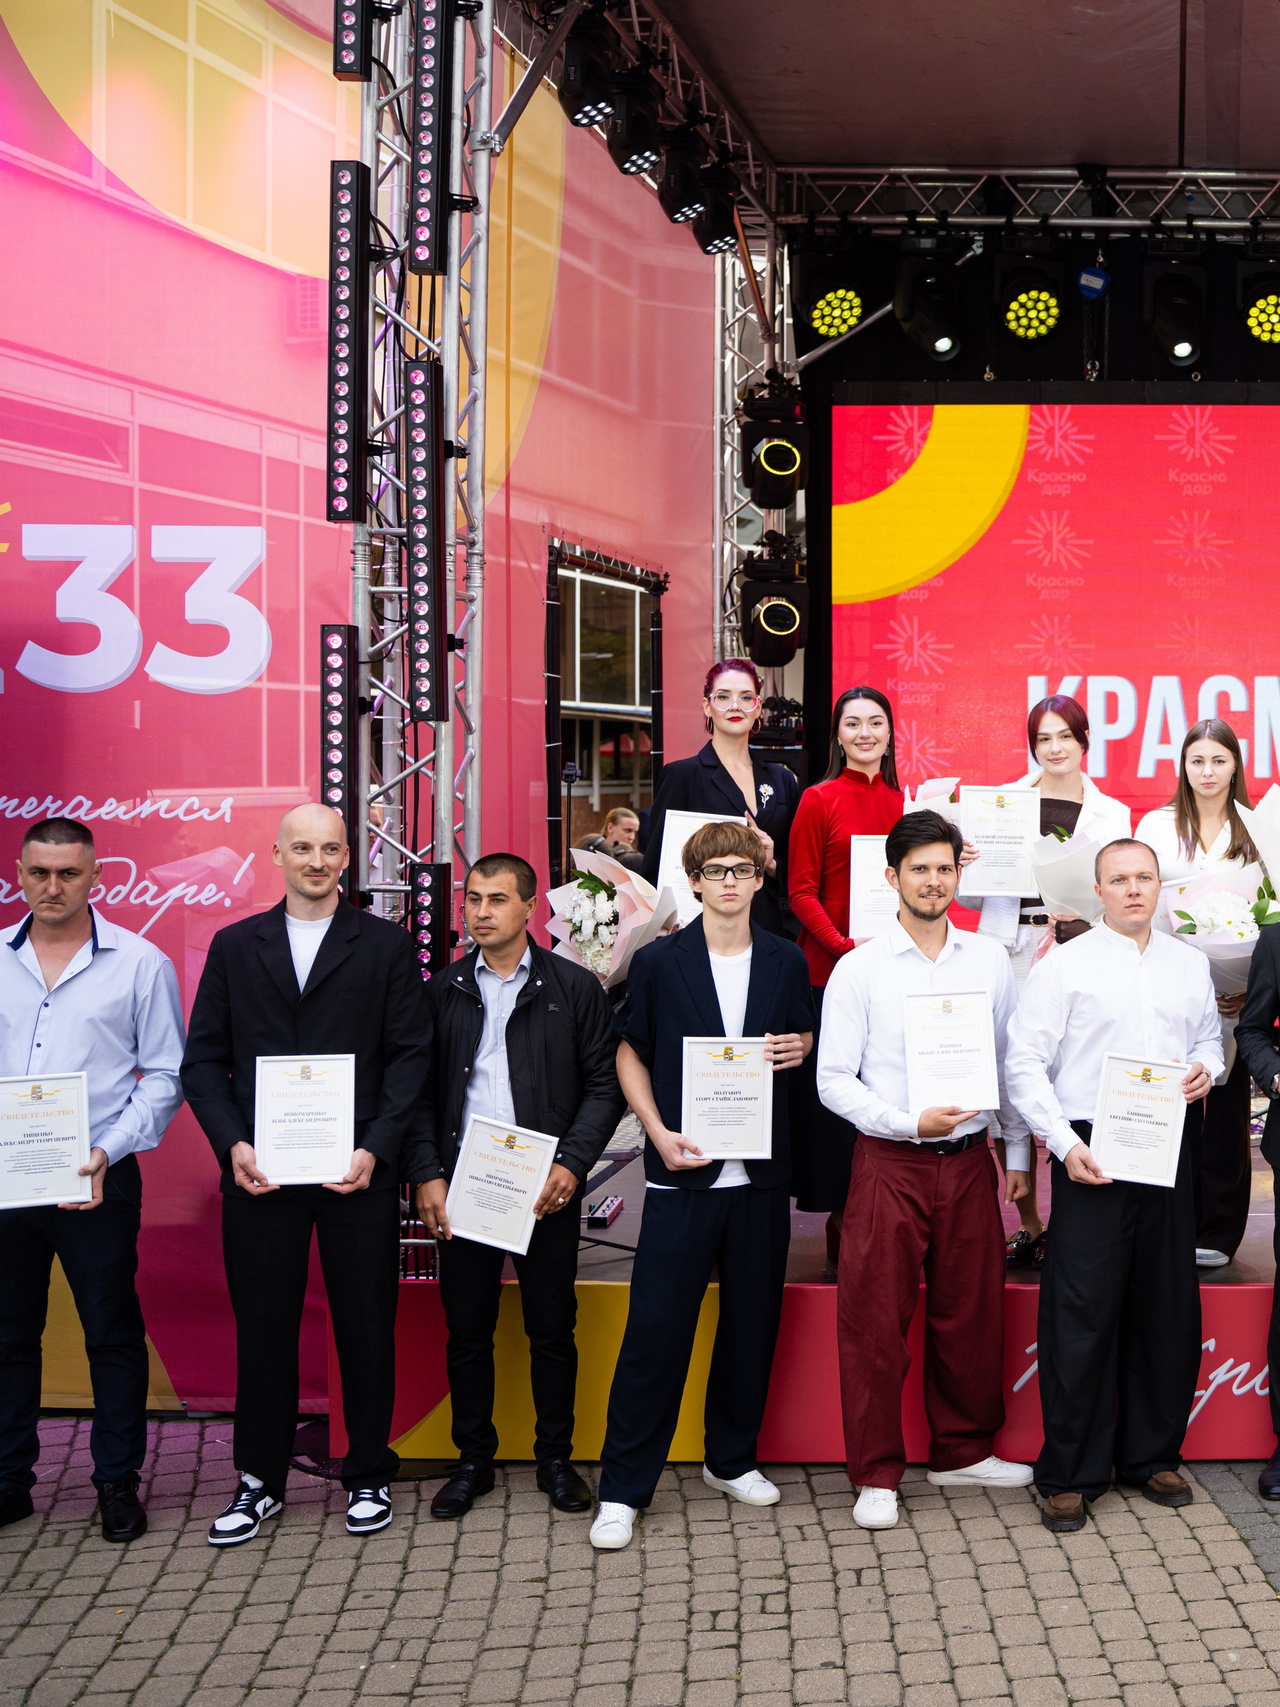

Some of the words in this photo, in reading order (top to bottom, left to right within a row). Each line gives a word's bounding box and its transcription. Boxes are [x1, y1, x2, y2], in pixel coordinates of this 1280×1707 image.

[1027, 469, 1086, 485] Красно
[1168, 469, 1227, 485] Красно
[1041, 482, 1070, 497] дар
[1182, 482, 1212, 497] дар
[1026, 573, 1085, 589] Красно
[1039, 587, 1070, 601] дар
[0, 523, 272, 695] 33
[886, 677, 945, 693] Красно
[0, 852, 255, 937] аодаре!
[1, 1109, 75, 1121] СВИДЕТЕЛЬСТВО
